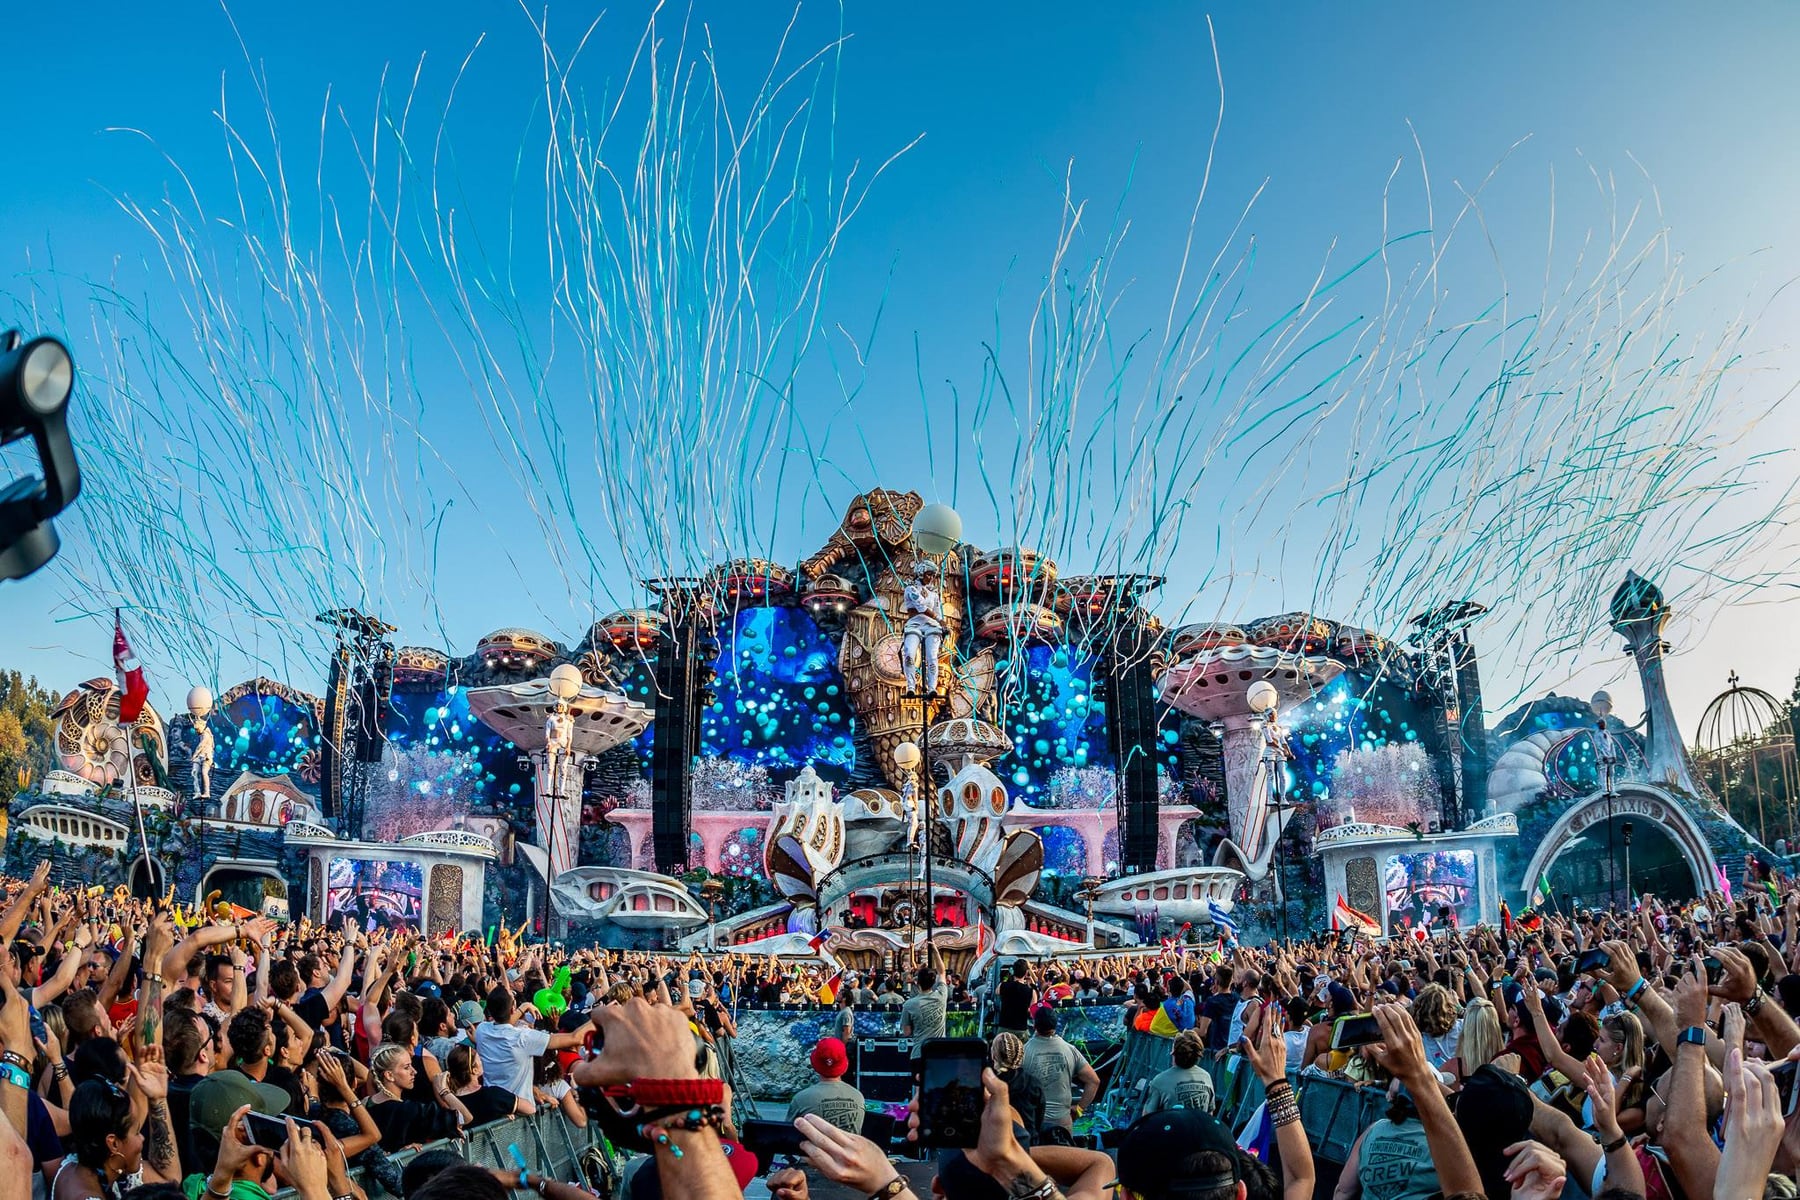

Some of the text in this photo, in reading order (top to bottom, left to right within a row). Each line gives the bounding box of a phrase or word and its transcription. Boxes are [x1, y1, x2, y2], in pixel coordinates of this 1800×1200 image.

[1583, 800, 1649, 824] PLANAXIS
[826, 1112, 859, 1127] REW
[1361, 1161, 1418, 1183] CREW
